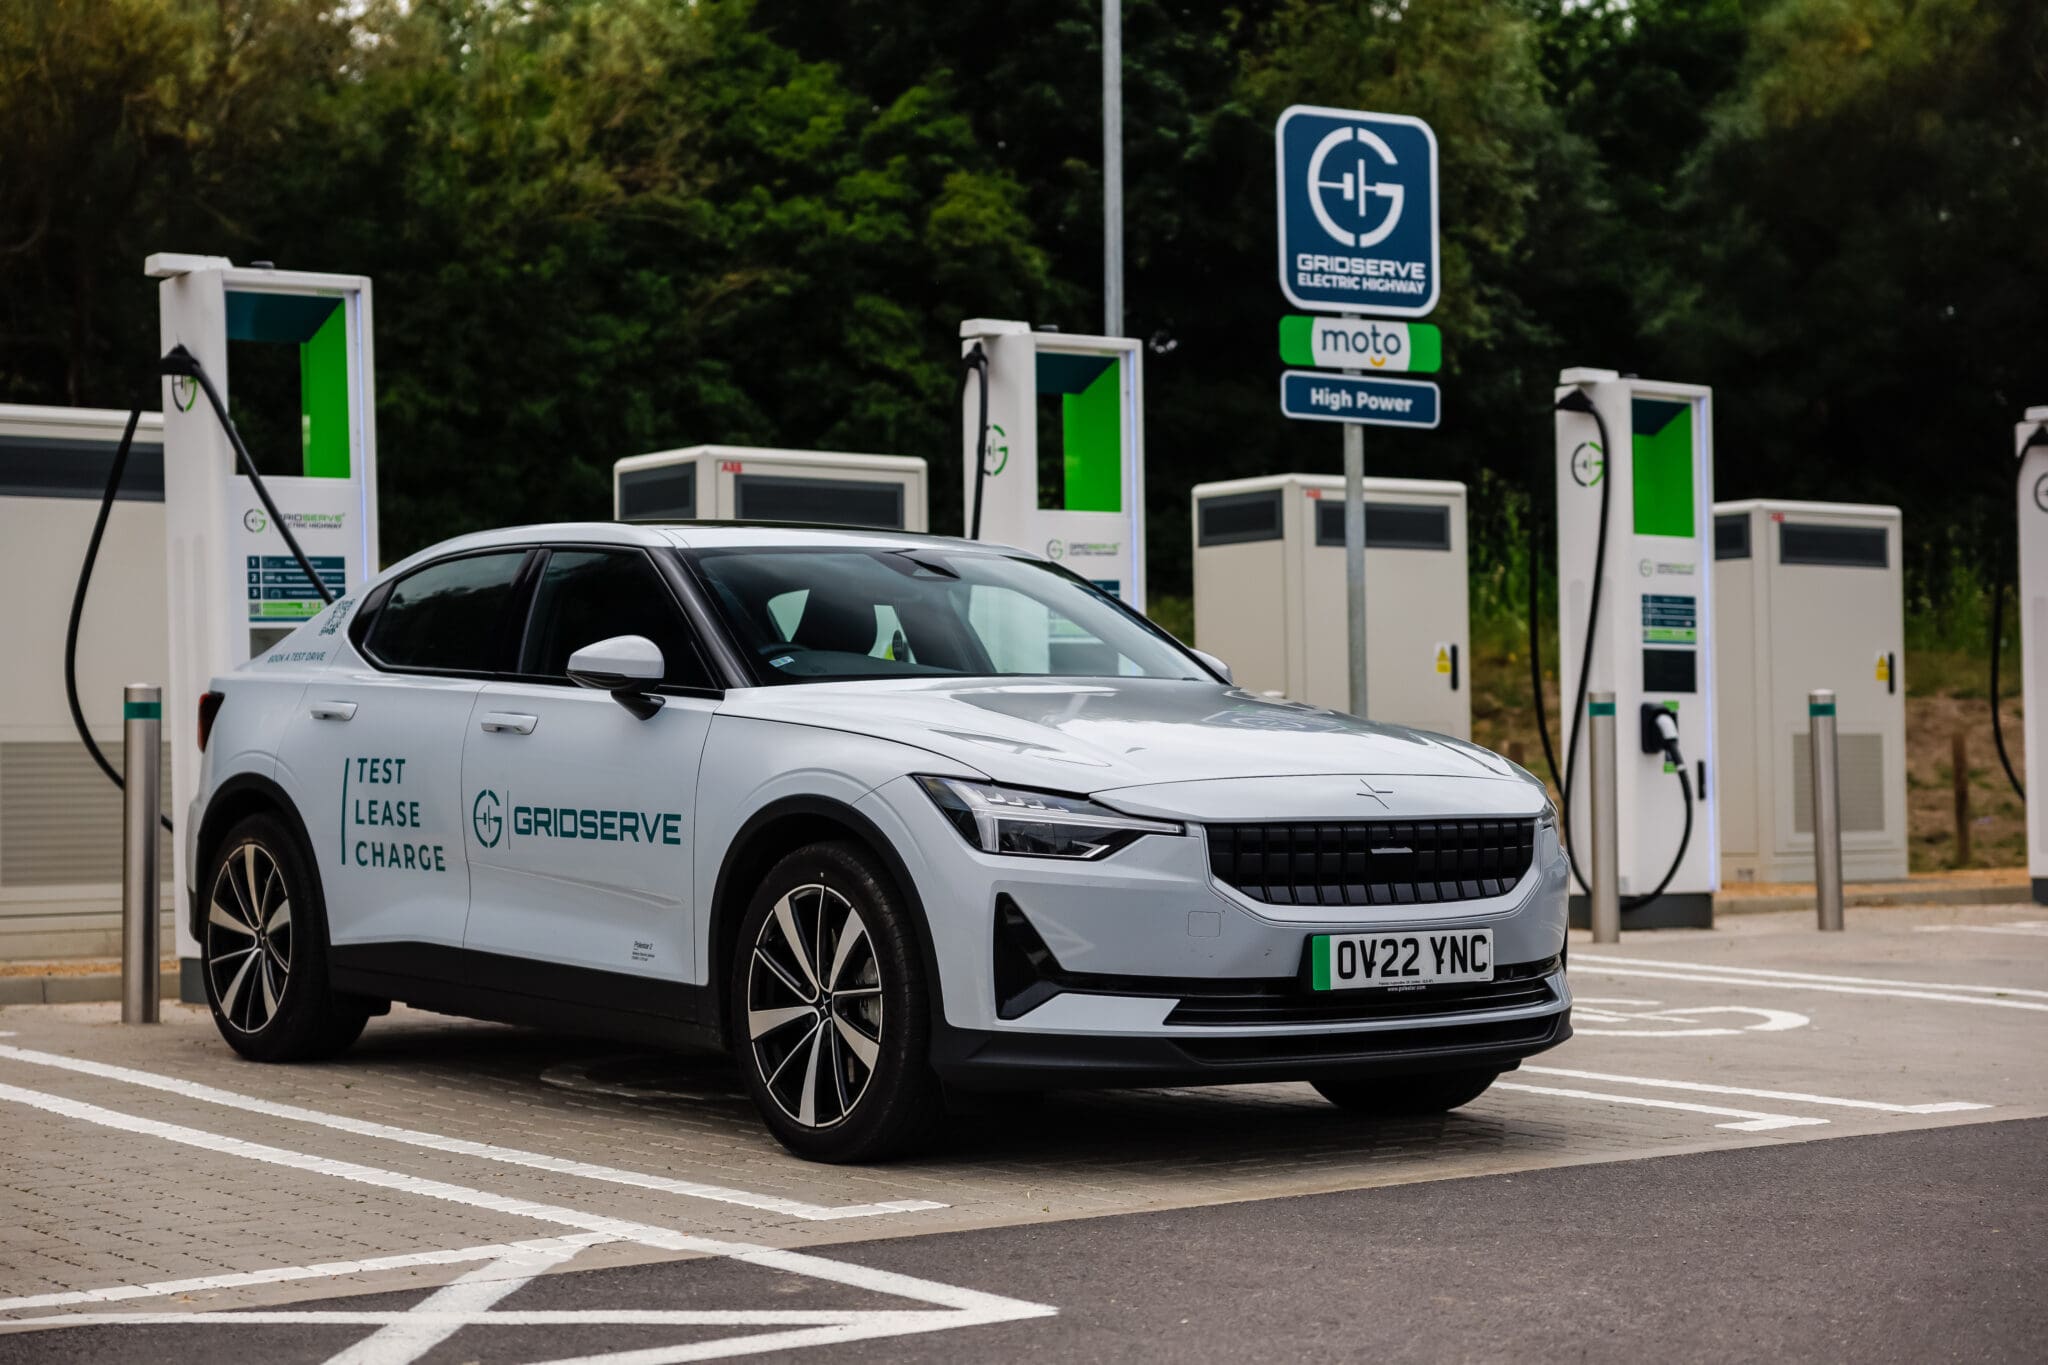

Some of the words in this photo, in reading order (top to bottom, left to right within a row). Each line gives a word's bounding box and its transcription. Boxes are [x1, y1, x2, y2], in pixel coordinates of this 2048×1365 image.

[1296, 253, 1426, 280] GRIDSERVE
[1297, 273, 1361, 290] ELECTRIC
[1362, 278, 1425, 295] HIGHWAY
[1321, 324, 1402, 356] moto
[1310, 387, 1352, 411] High
[1356, 391, 1413, 412] Power
[357, 758, 406, 784] TEST
[355, 799, 420, 827] LEASE
[514, 806, 682, 845] GRIDSERVE
[355, 841, 446, 871] CHARGE
[1338, 938, 1420, 980] OV22
[1430, 934, 1488, 975] YNC
